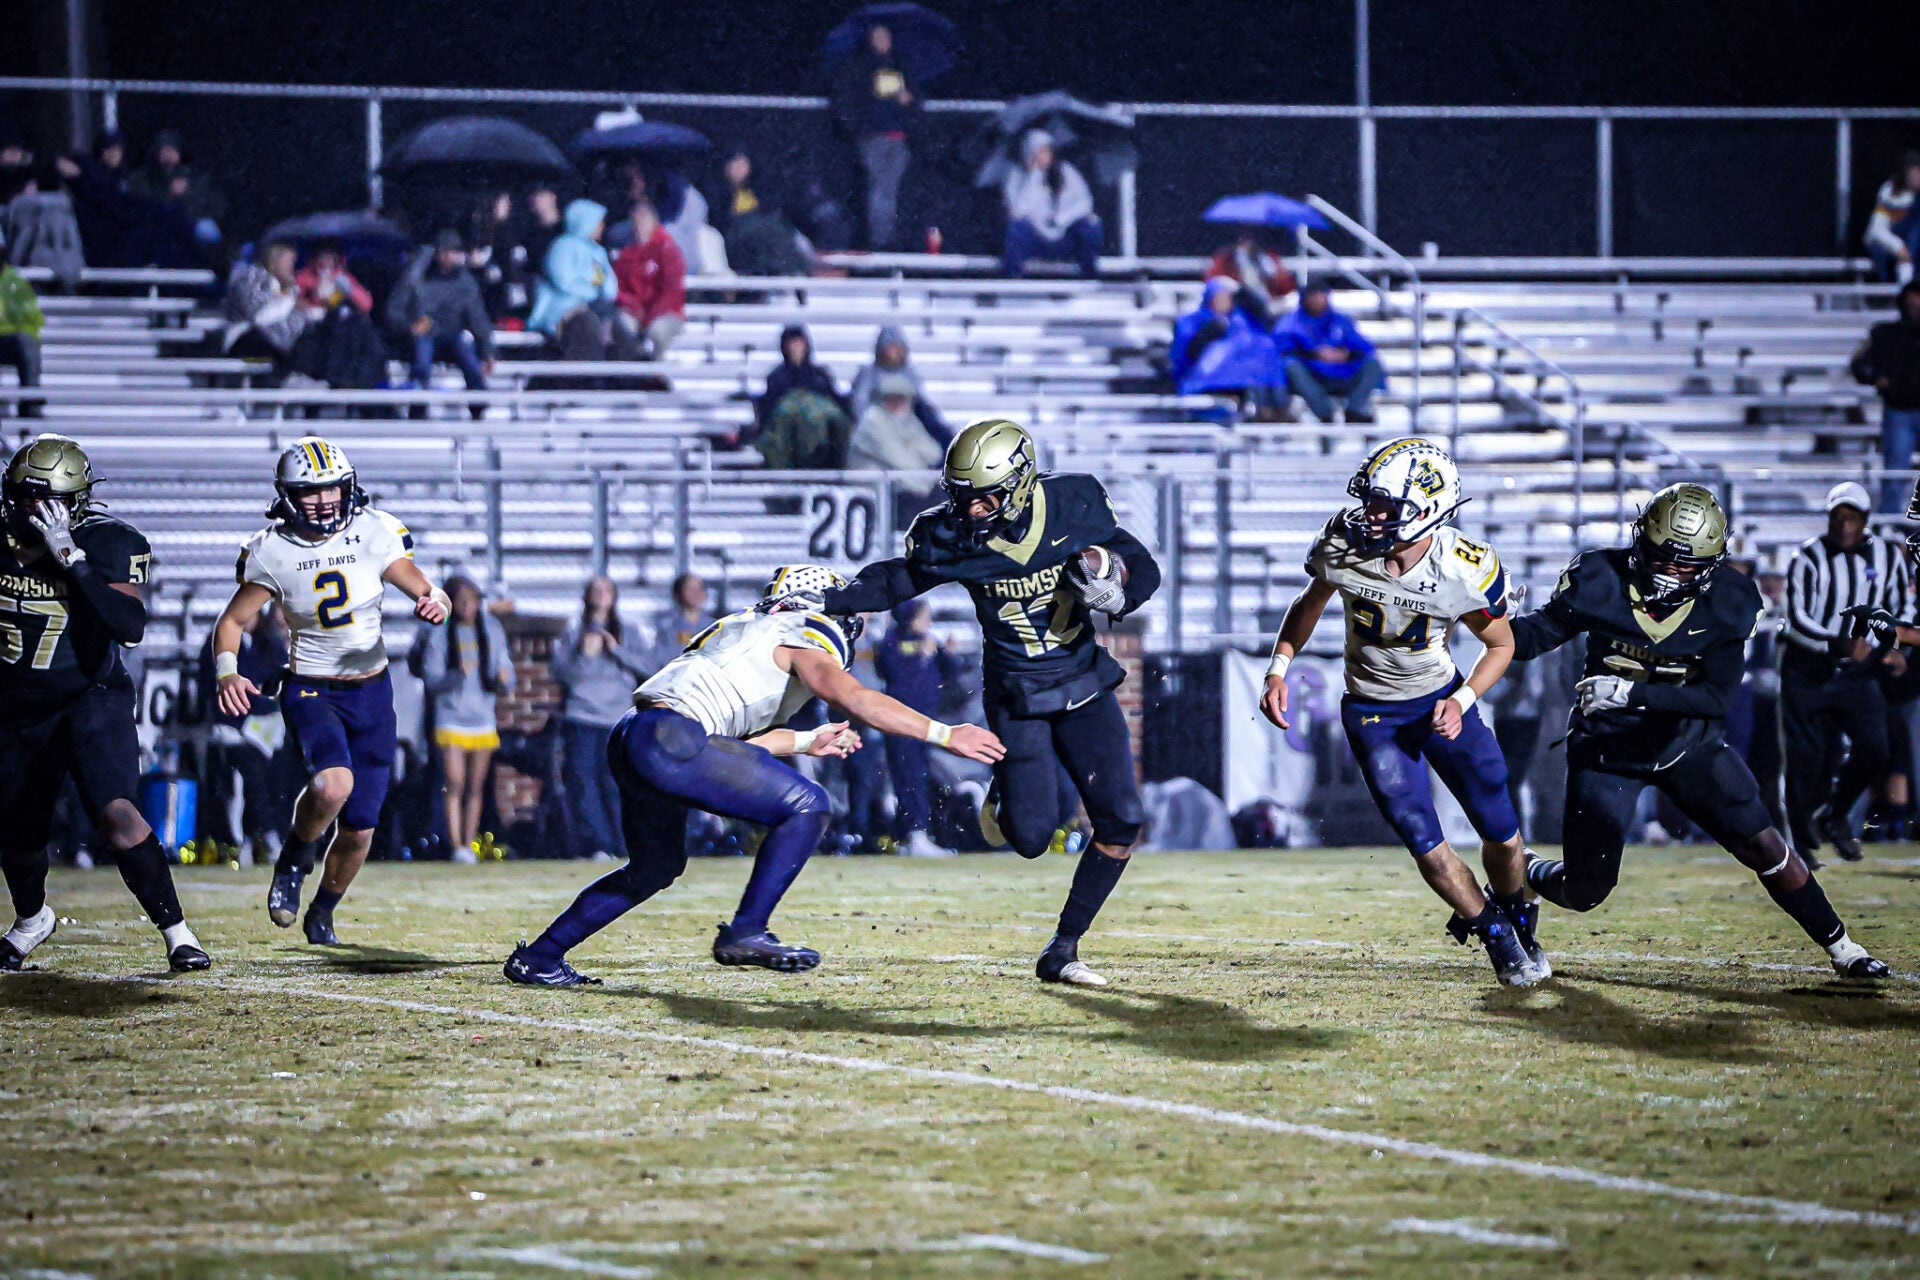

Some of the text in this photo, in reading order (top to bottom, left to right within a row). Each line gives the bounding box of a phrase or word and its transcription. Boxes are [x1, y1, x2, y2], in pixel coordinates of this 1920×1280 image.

[809, 494, 876, 561] 20
[129, 553, 151, 583] 57
[296, 554, 356, 571] JEFF DAVIS
[1454, 537, 1488, 568] 24
[313, 568, 355, 629] 2
[1357, 586, 1426, 612] JEFF DAVIS
[998, 592, 1084, 658] 12
[1352, 600, 1432, 653] 24
